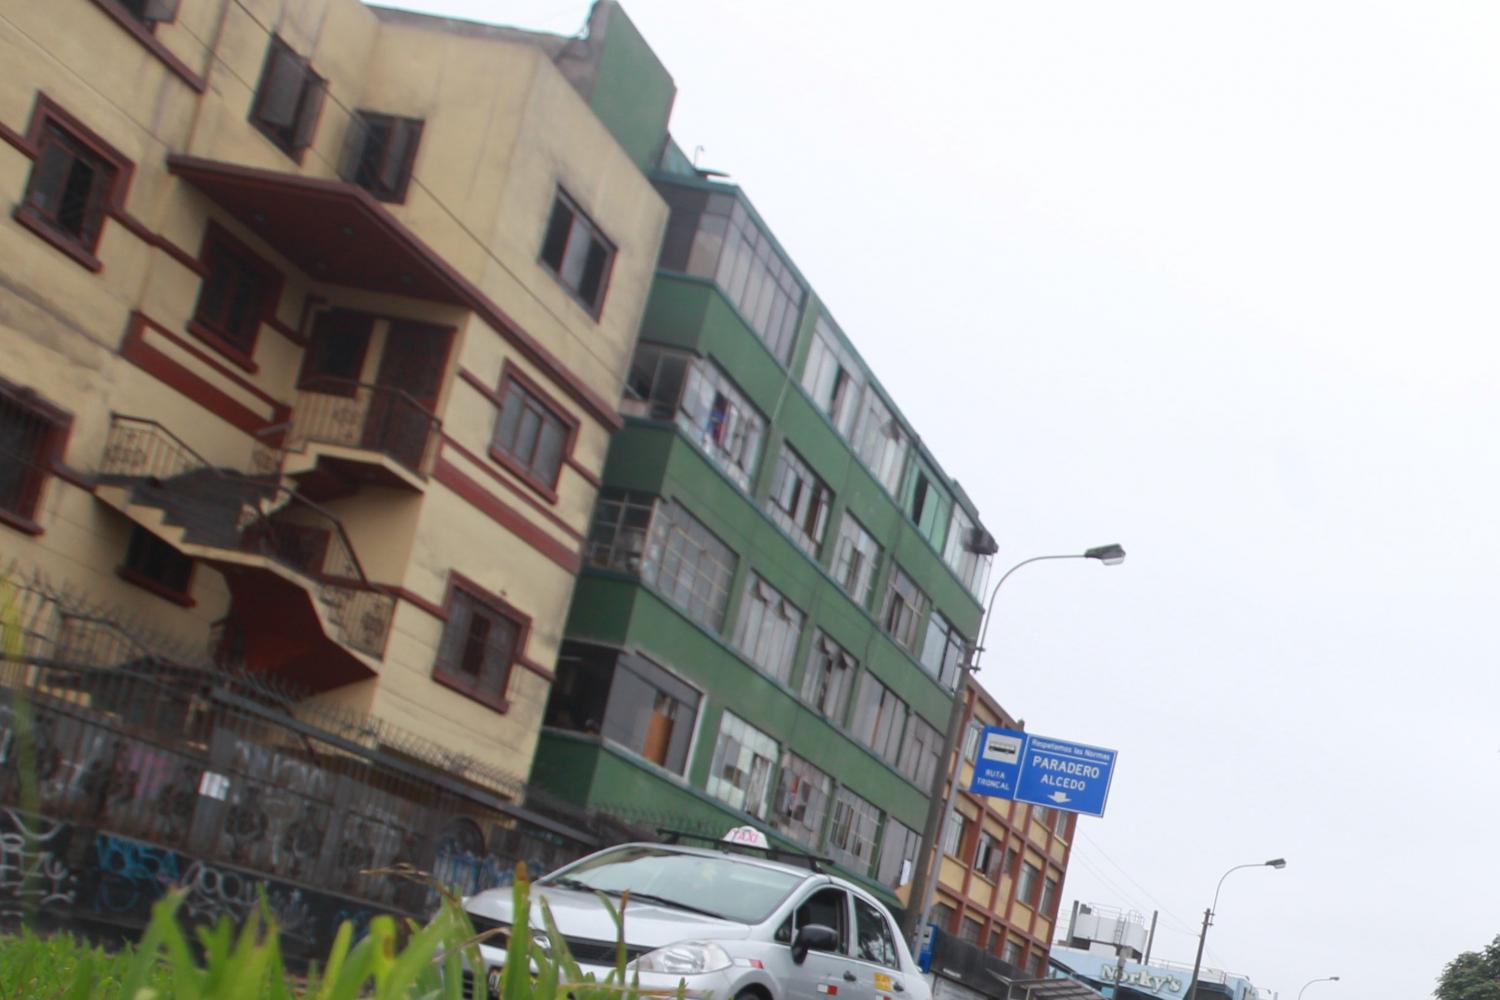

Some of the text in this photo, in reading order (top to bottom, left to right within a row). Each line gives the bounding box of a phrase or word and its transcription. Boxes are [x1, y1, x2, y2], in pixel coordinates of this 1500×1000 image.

[985, 769, 1005, 779] RUTA
[1032, 755, 1100, 779] PARADERO
[977, 777, 1010, 791] TRONCAL
[1040, 774, 1086, 791] ALCEDO
[1101, 964, 1182, 993] Norky's
